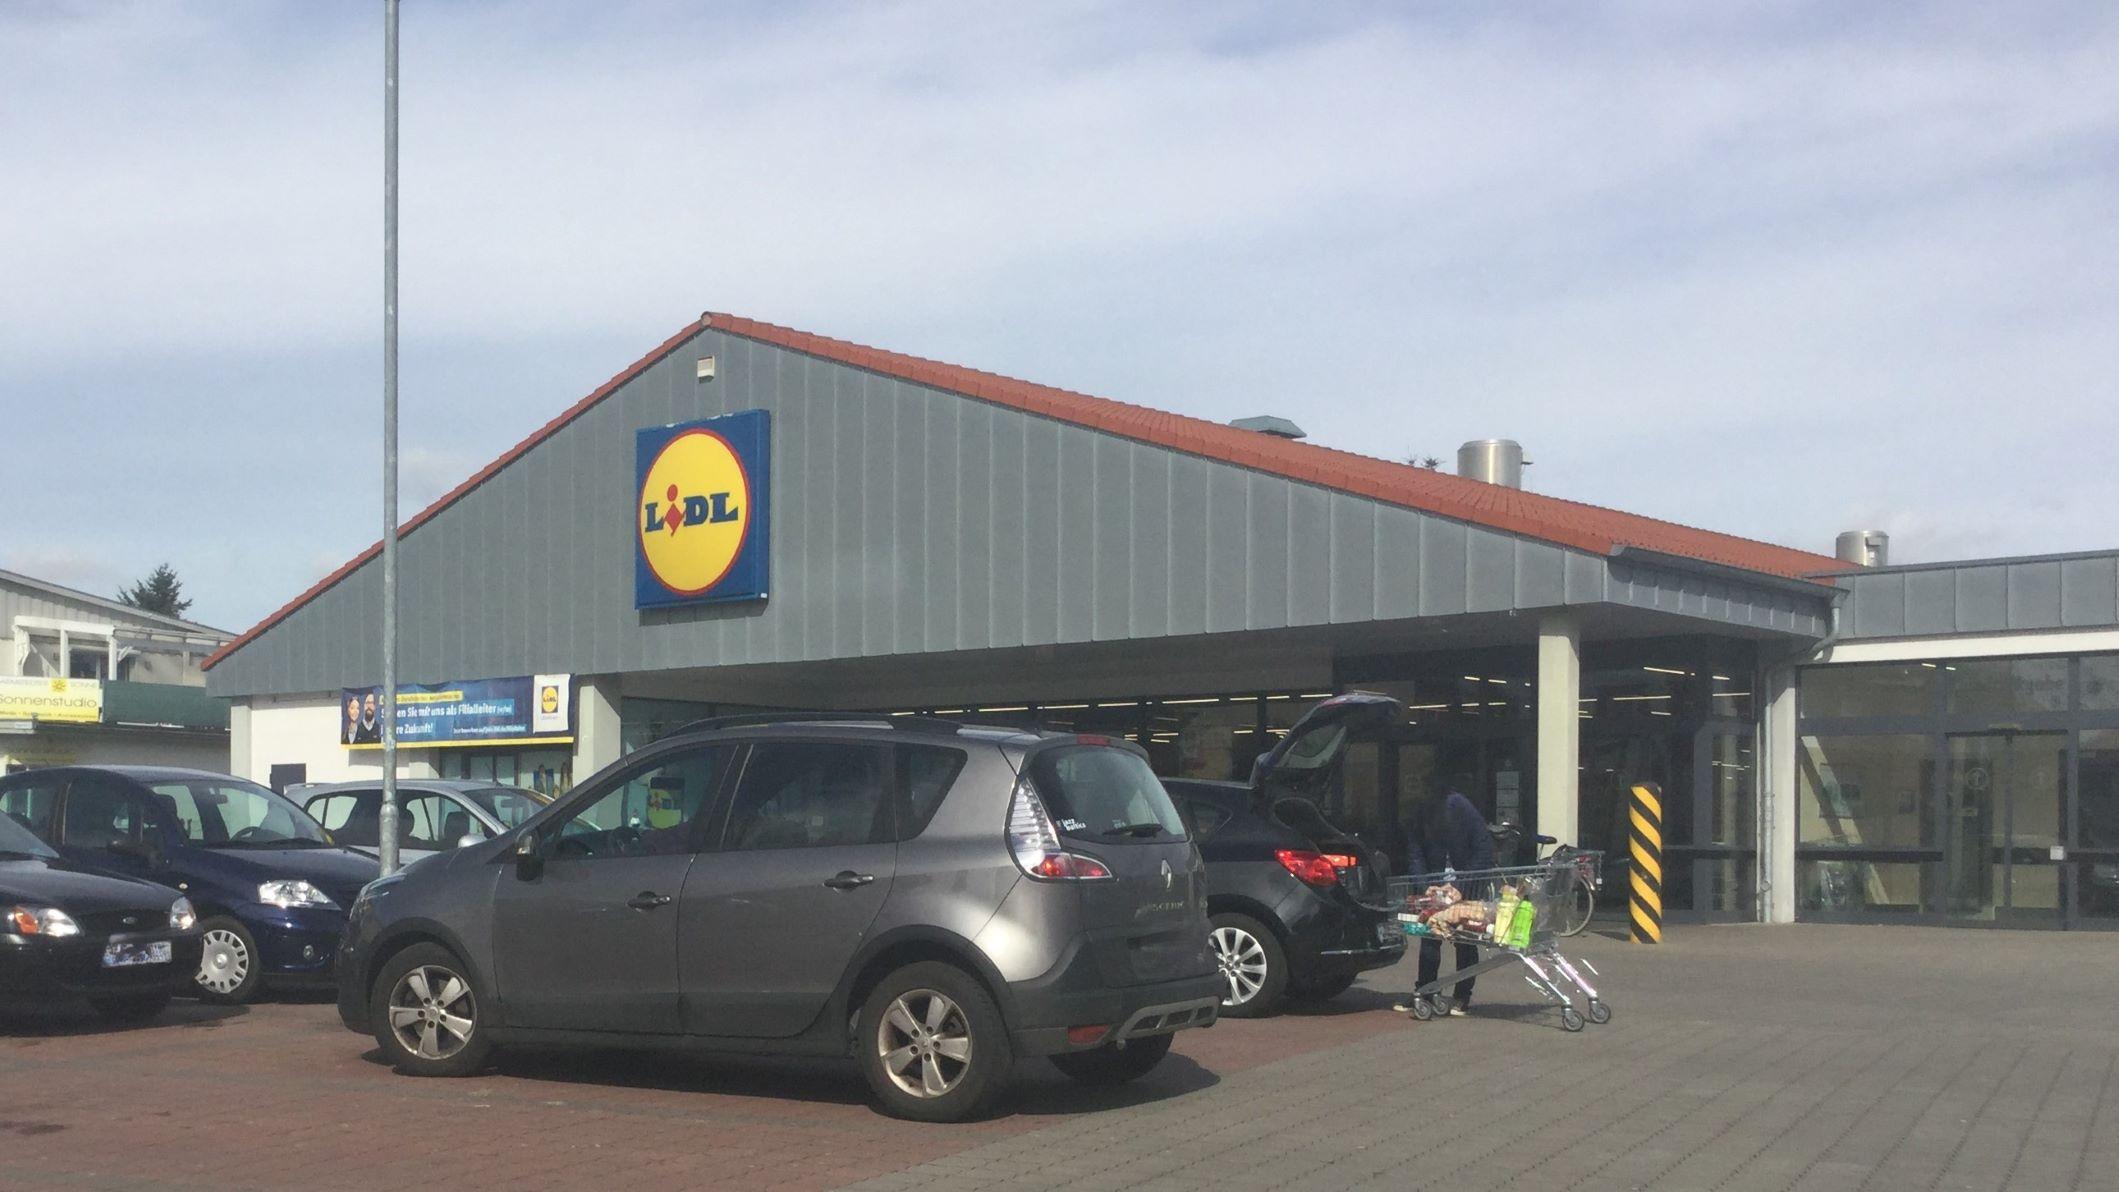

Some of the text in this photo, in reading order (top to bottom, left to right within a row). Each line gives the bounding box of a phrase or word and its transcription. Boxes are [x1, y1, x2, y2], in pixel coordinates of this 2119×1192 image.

[407, 706, 418, 717] Sie
[418, 706, 431, 716] mit
[431, 707, 445, 716] uns
[446, 704, 457, 716] als
[458, 702, 496, 715] Filialleiter
[404, 723, 433, 734] Zukunft!
